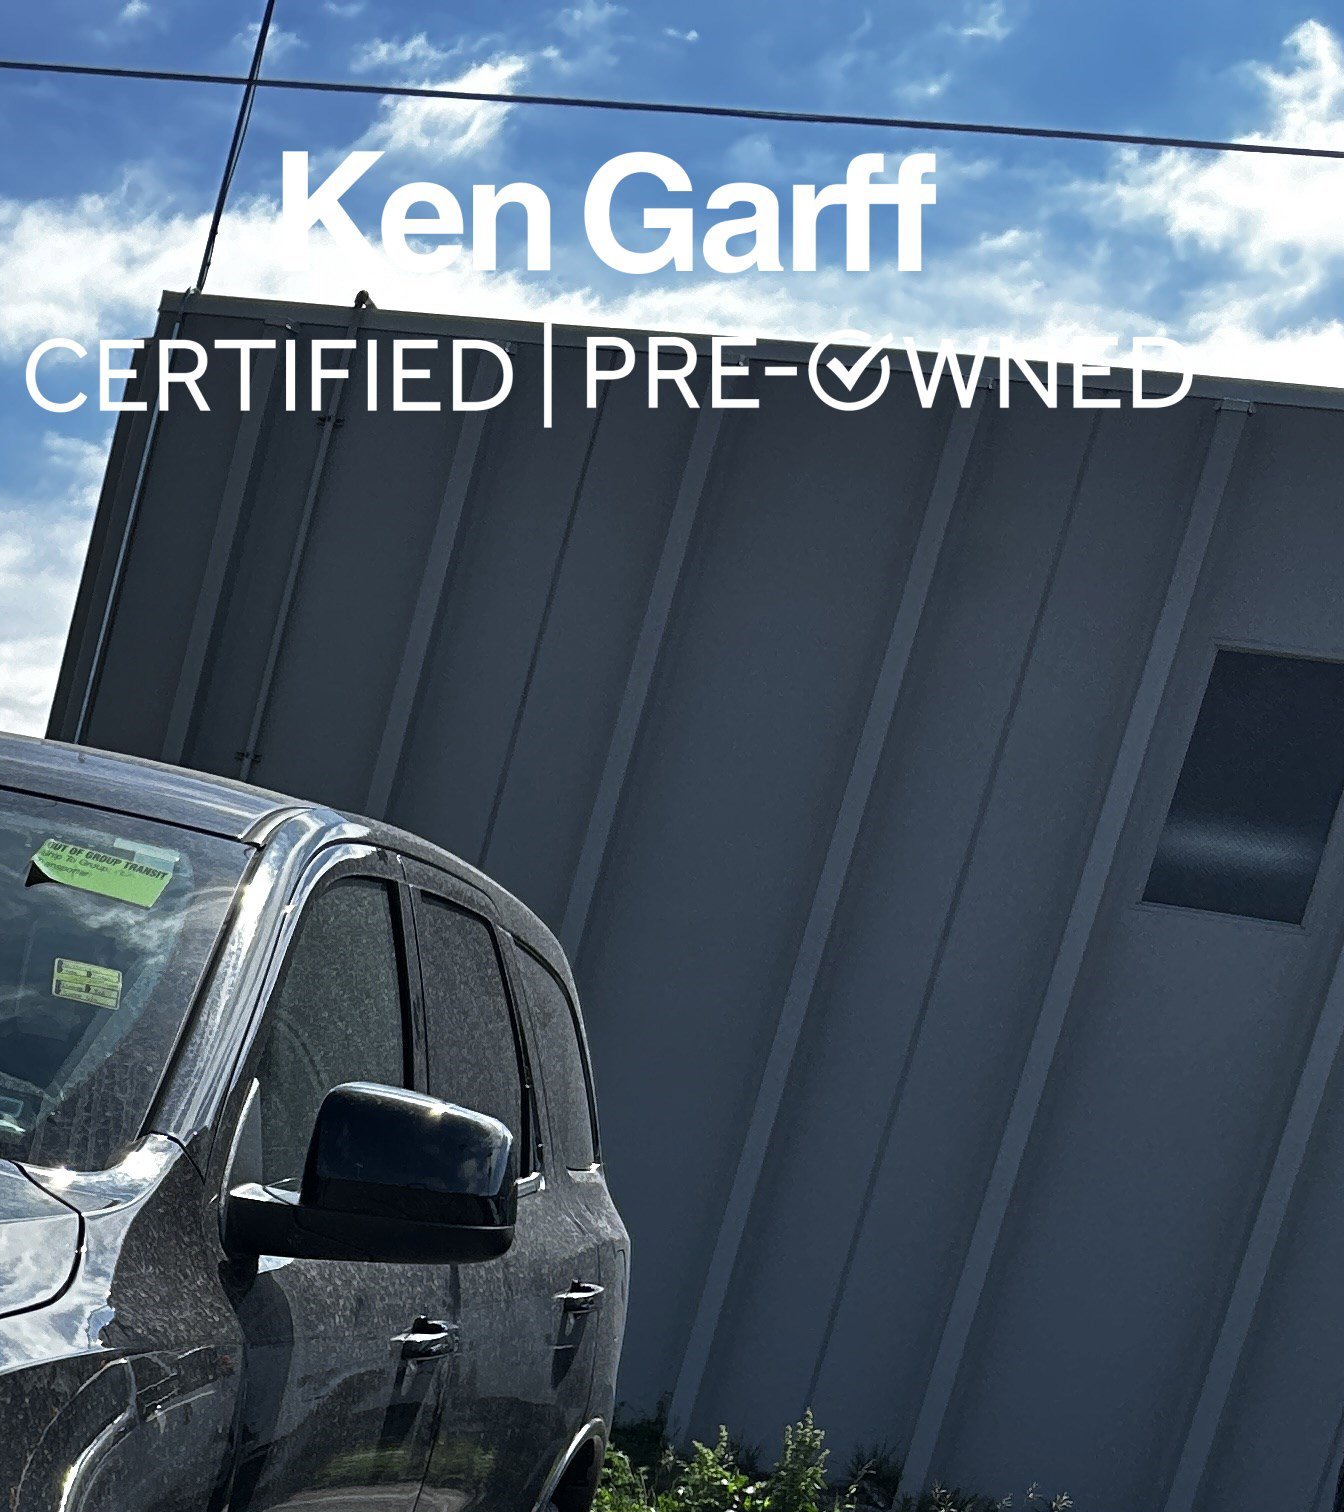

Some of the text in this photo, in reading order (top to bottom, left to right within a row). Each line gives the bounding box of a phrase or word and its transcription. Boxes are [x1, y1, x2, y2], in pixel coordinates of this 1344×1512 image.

[47, 841, 68, 853] OUT
[69, 847, 85, 856] OF
[85, 851, 122, 867] GROUP
[123, 862, 169, 880] TRANSIT
